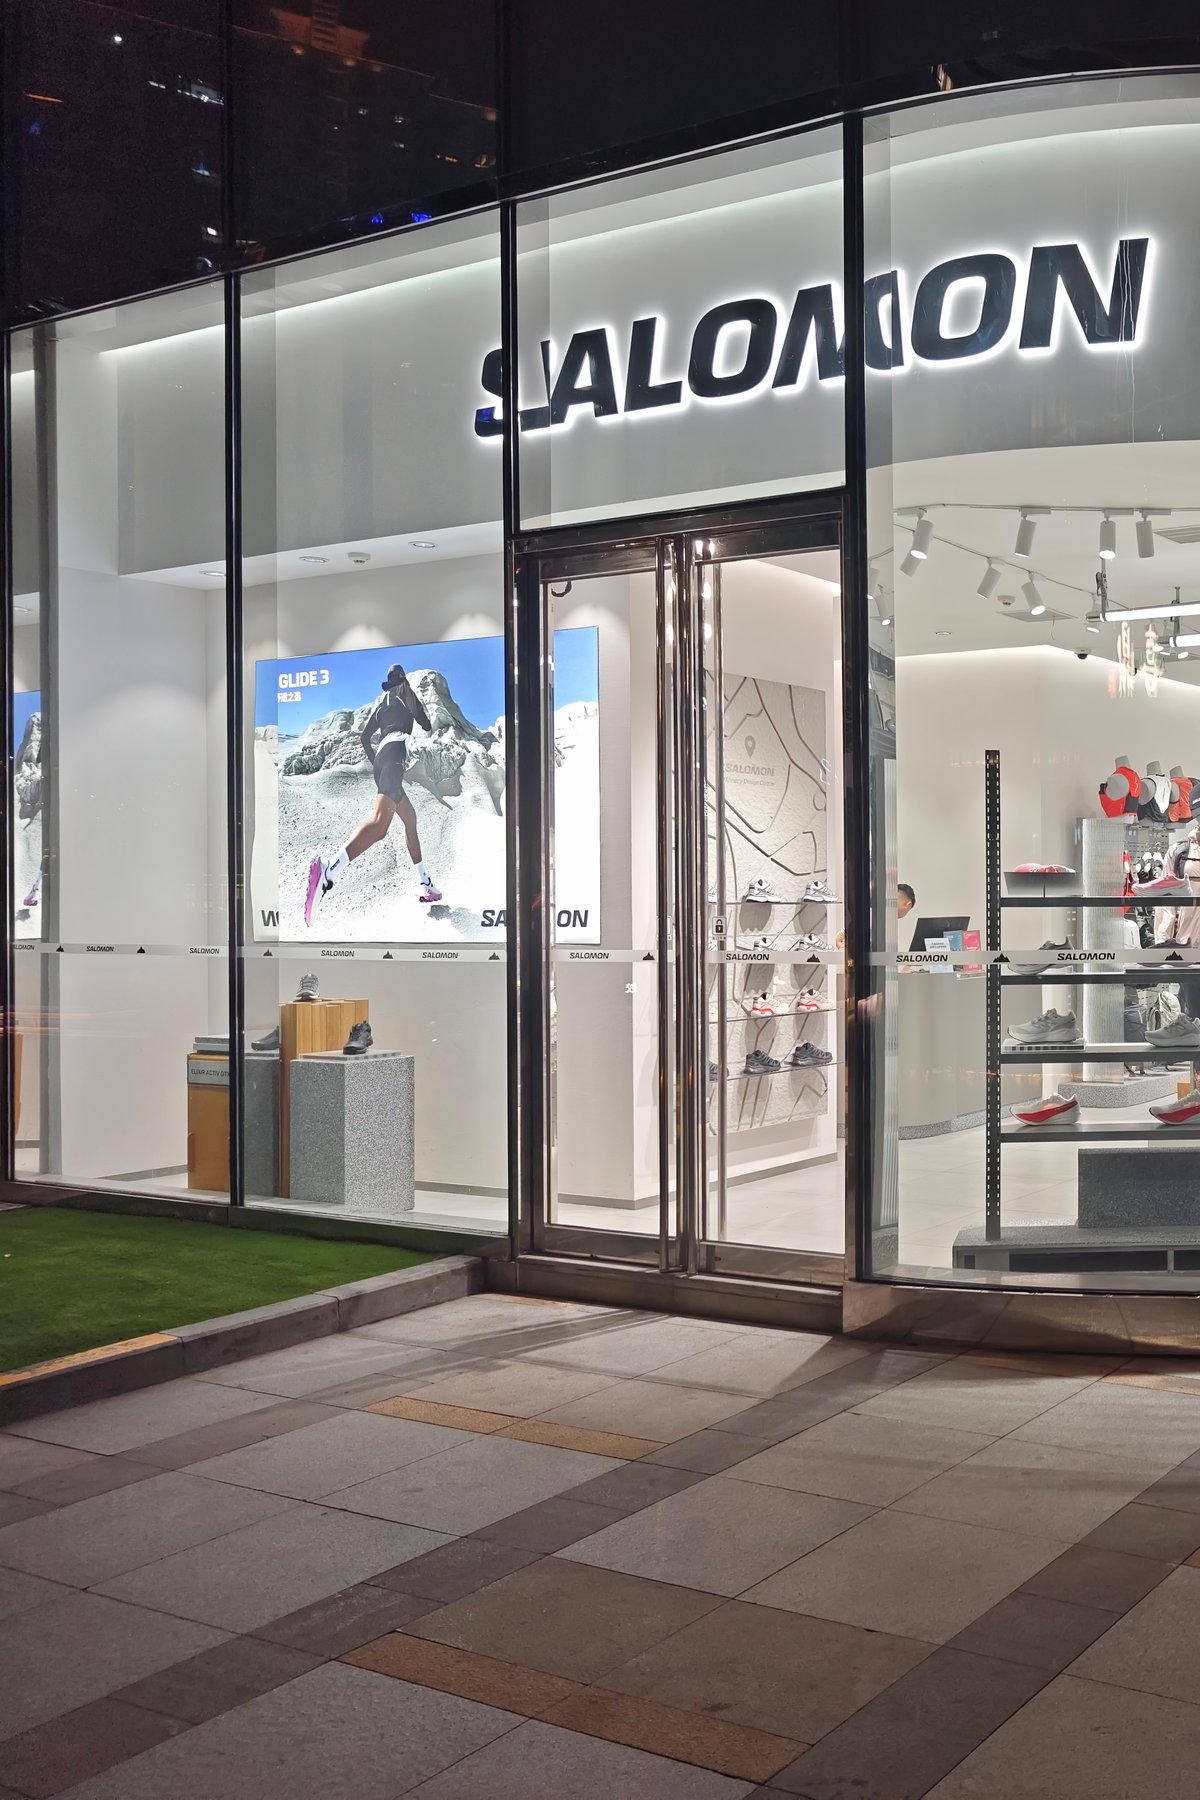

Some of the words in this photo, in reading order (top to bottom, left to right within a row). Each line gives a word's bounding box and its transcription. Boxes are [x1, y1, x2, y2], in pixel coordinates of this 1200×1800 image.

[278, 670, 318, 689] GLIDE
[320, 669, 329, 685] 3
[320, 950, 355, 958] SALOMON
[422, 952, 459, 960] SALOMON
[569, 952, 610, 960] SALOMON
[725, 953, 770, 961] SALOMON
[1057, 951, 1116, 961] SALOMON
[896, 954, 949, 963] SALOMON
